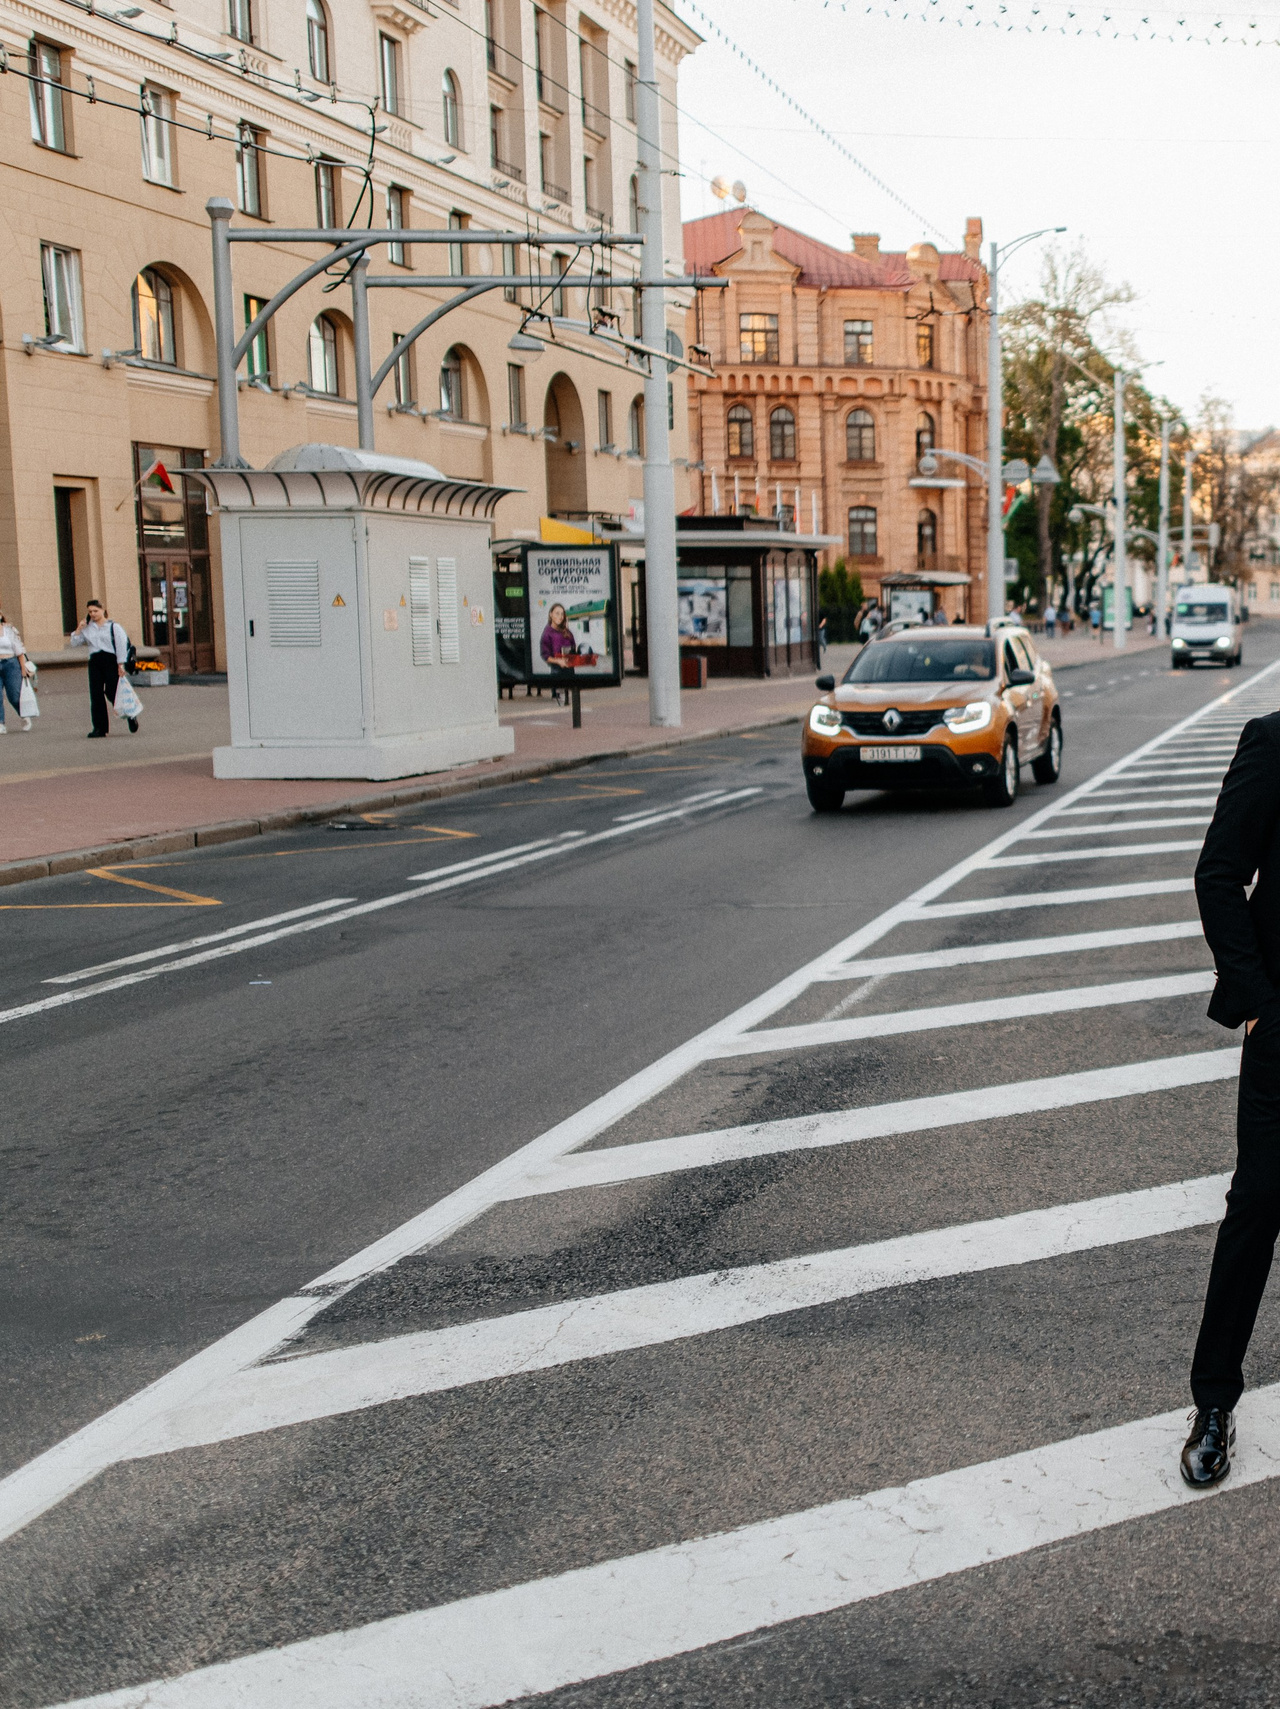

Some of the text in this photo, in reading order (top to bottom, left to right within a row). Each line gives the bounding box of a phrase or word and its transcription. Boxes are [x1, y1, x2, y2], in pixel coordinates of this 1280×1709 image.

[537, 557, 601, 567] ПРАВИЛЬНАЯ
[538, 567, 601, 576] СОРТИРОВКА
[550, 575, 589, 584] МУСОРА
[869, 748, 891, 759] 3191
